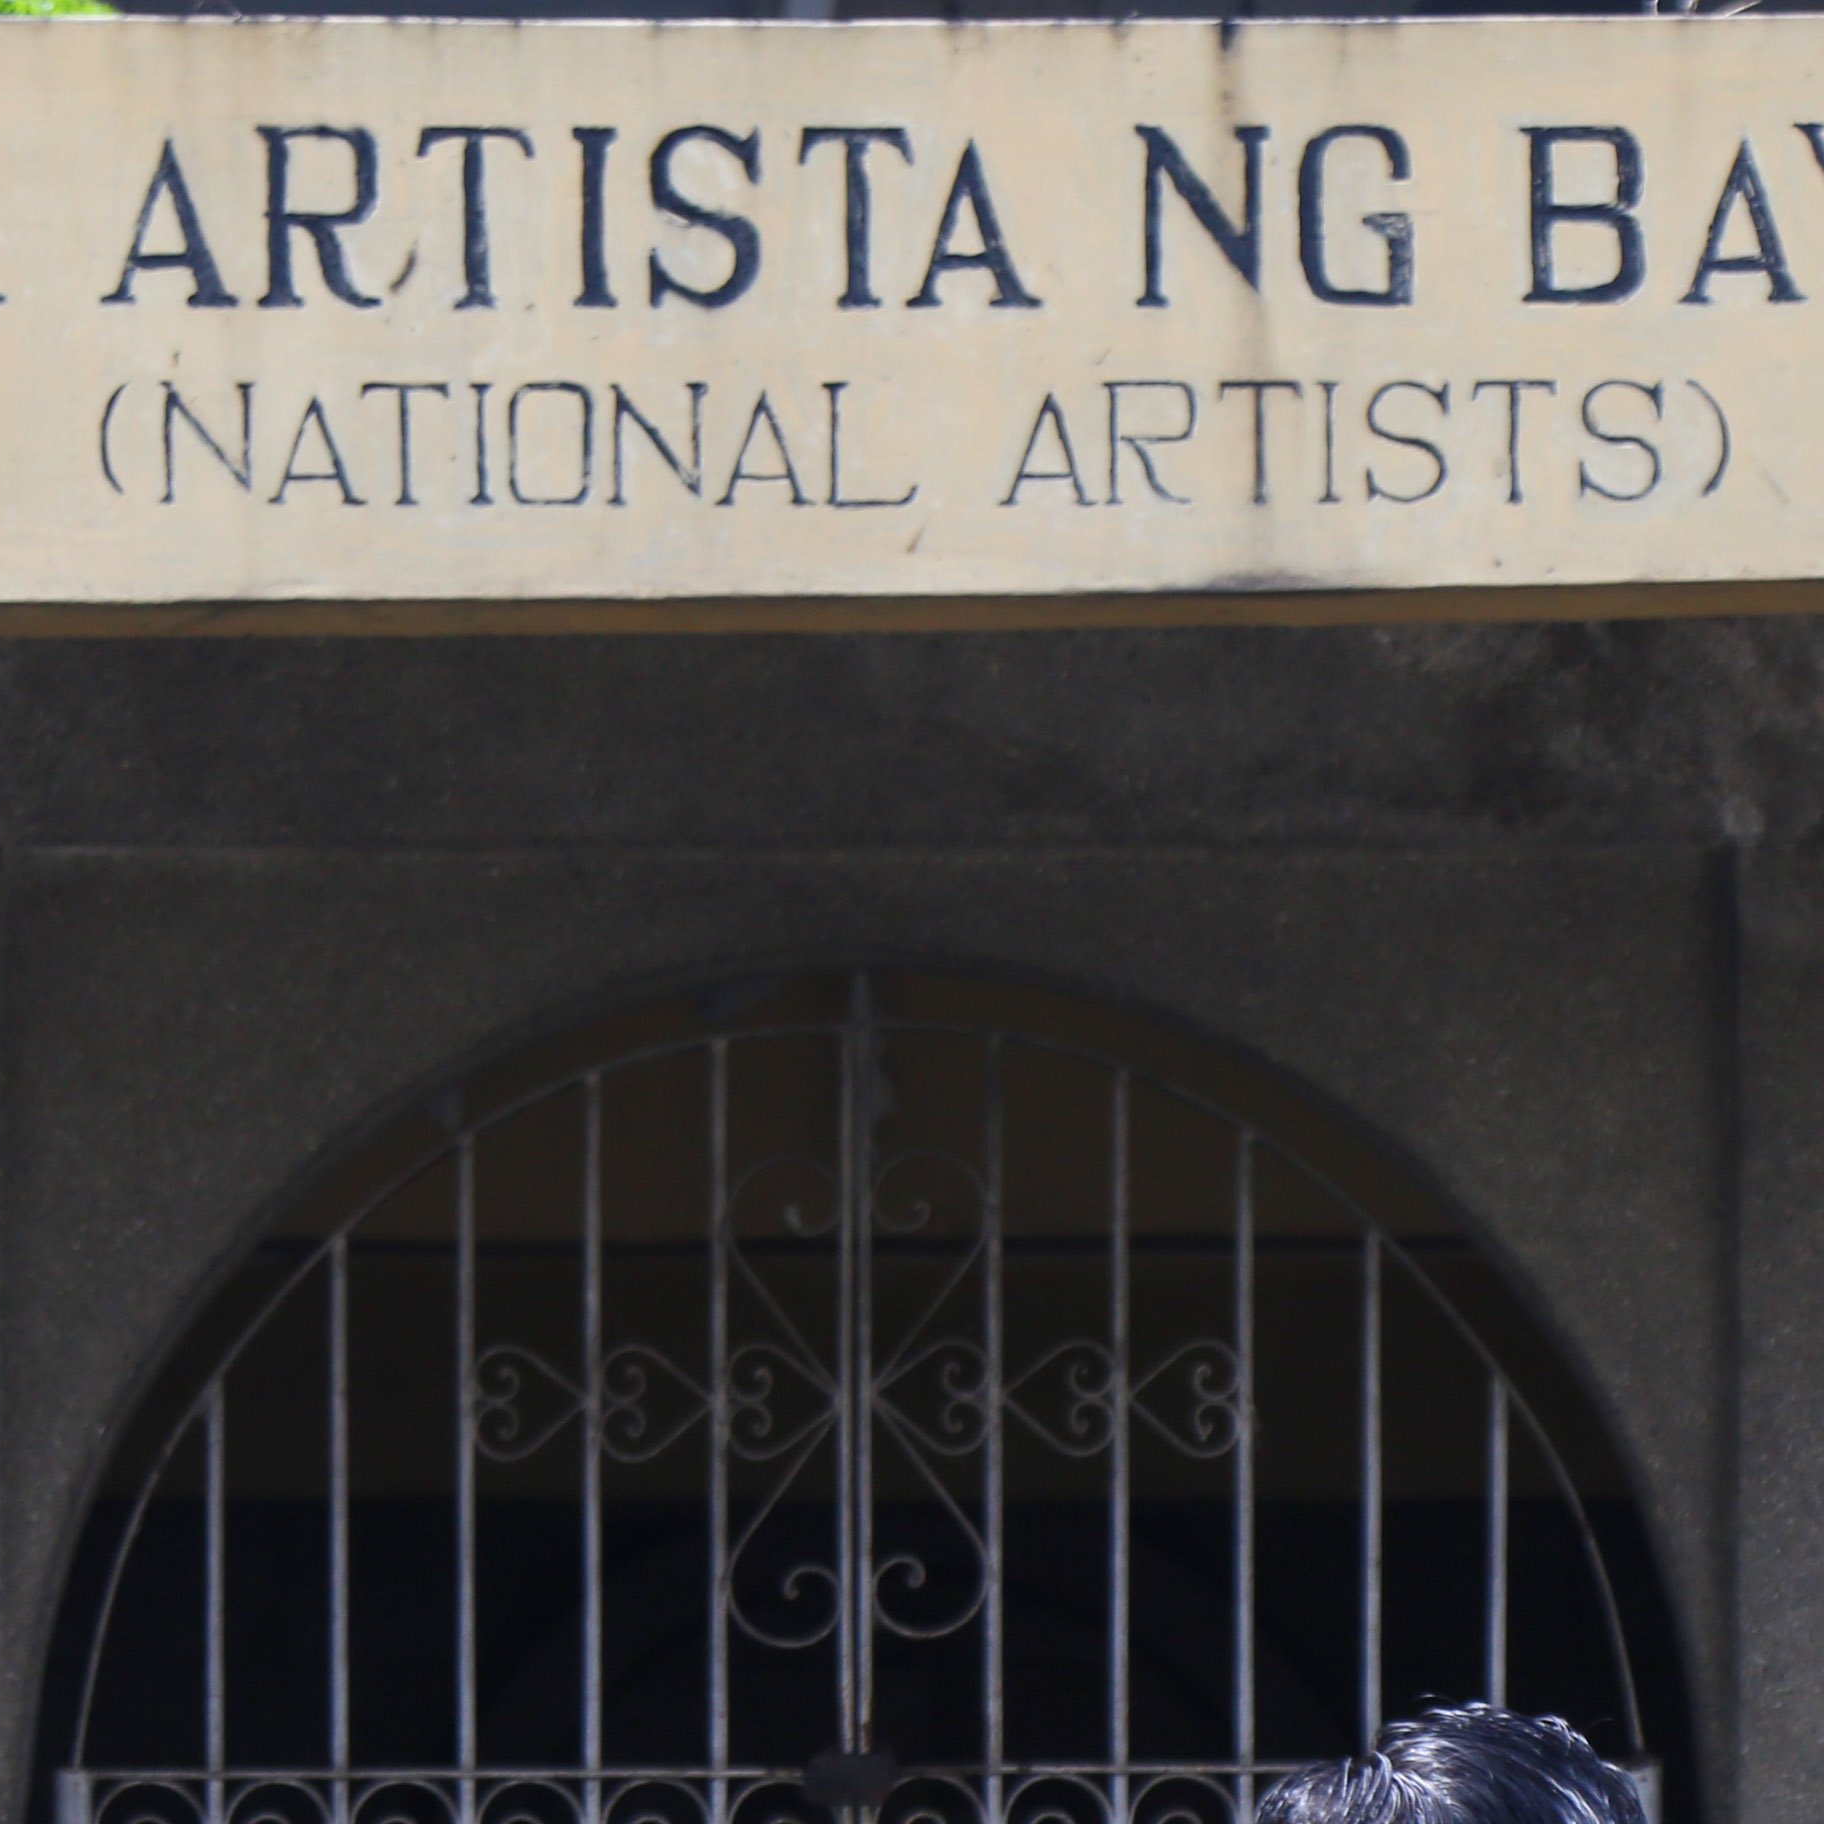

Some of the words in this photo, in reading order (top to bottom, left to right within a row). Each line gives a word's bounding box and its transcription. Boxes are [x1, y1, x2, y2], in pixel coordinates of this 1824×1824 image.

[100, 123, 1042, 311] ARTISTA
[1134, 123, 1413, 308] NG
[96, 379, 918, 508] (NATIONAL
[1000, 378, 1732, 506] ARTISTS)
